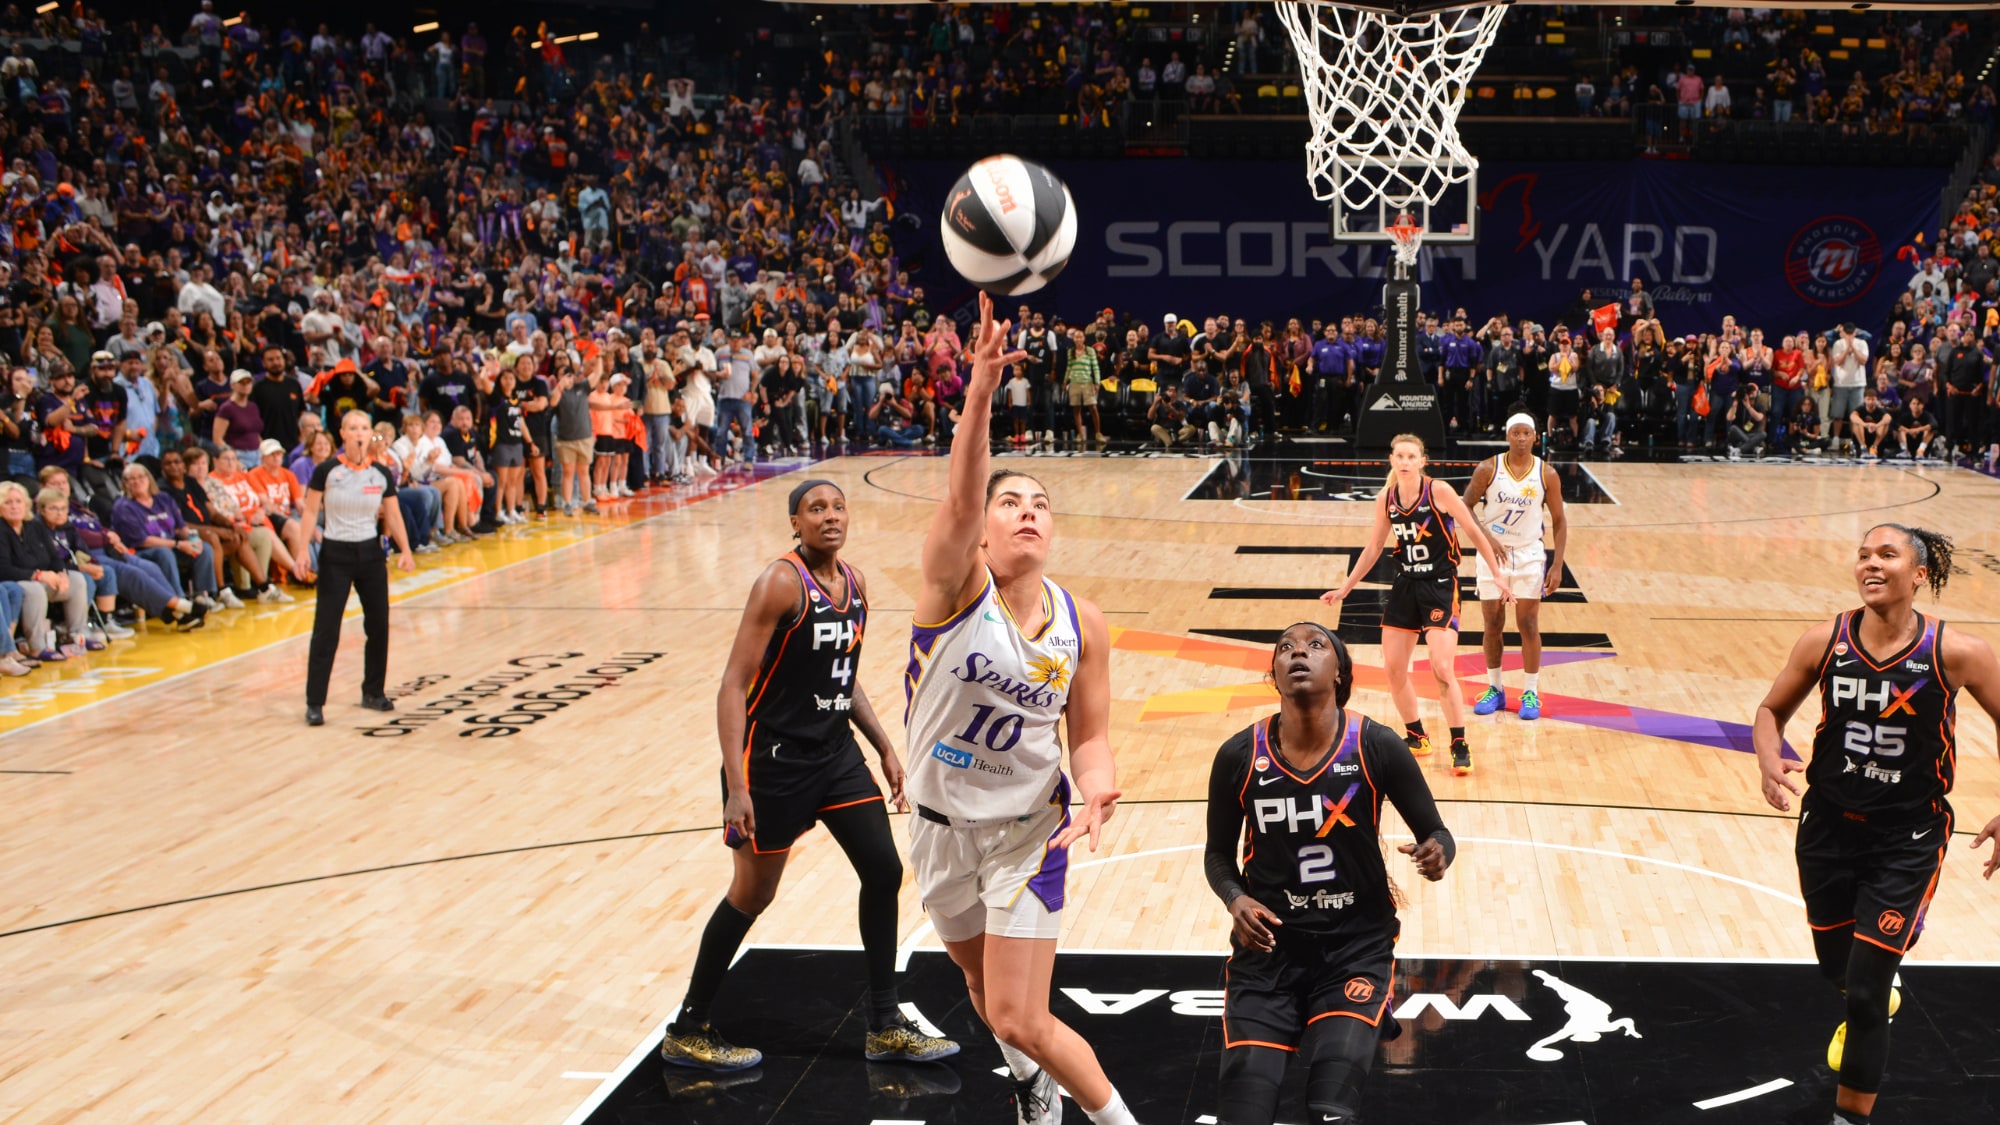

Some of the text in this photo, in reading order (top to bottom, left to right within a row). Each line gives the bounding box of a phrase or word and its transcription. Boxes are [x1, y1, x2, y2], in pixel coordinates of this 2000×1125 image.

[1534, 223, 1717, 284] YARD
[1806, 267, 1868, 299] MERCURY
[1397, 292, 1408, 369] Banner Health
[1391, 515, 1432, 543] PHX
[1501, 509, 1525, 526] 17
[1406, 544, 1430, 563] 10
[812, 610, 863, 653] PHX
[1048, 636, 1077, 648] Albert
[831, 656, 852, 687] 4
[951, 652, 1058, 708] SPARKS
[459, 652, 668, 738] mortgage
[1832, 676, 1928, 718] PHX
[954, 704, 1024, 752] 10
[1844, 720, 1907, 757] 25
[936, 748, 1014, 776] UCLA Health
[1253, 783, 1361, 838] PHX
[1298, 844, 1336, 884] 2
[1311, 889, 1354, 909] fry's
[1060, 987, 1532, 1021] WBA
